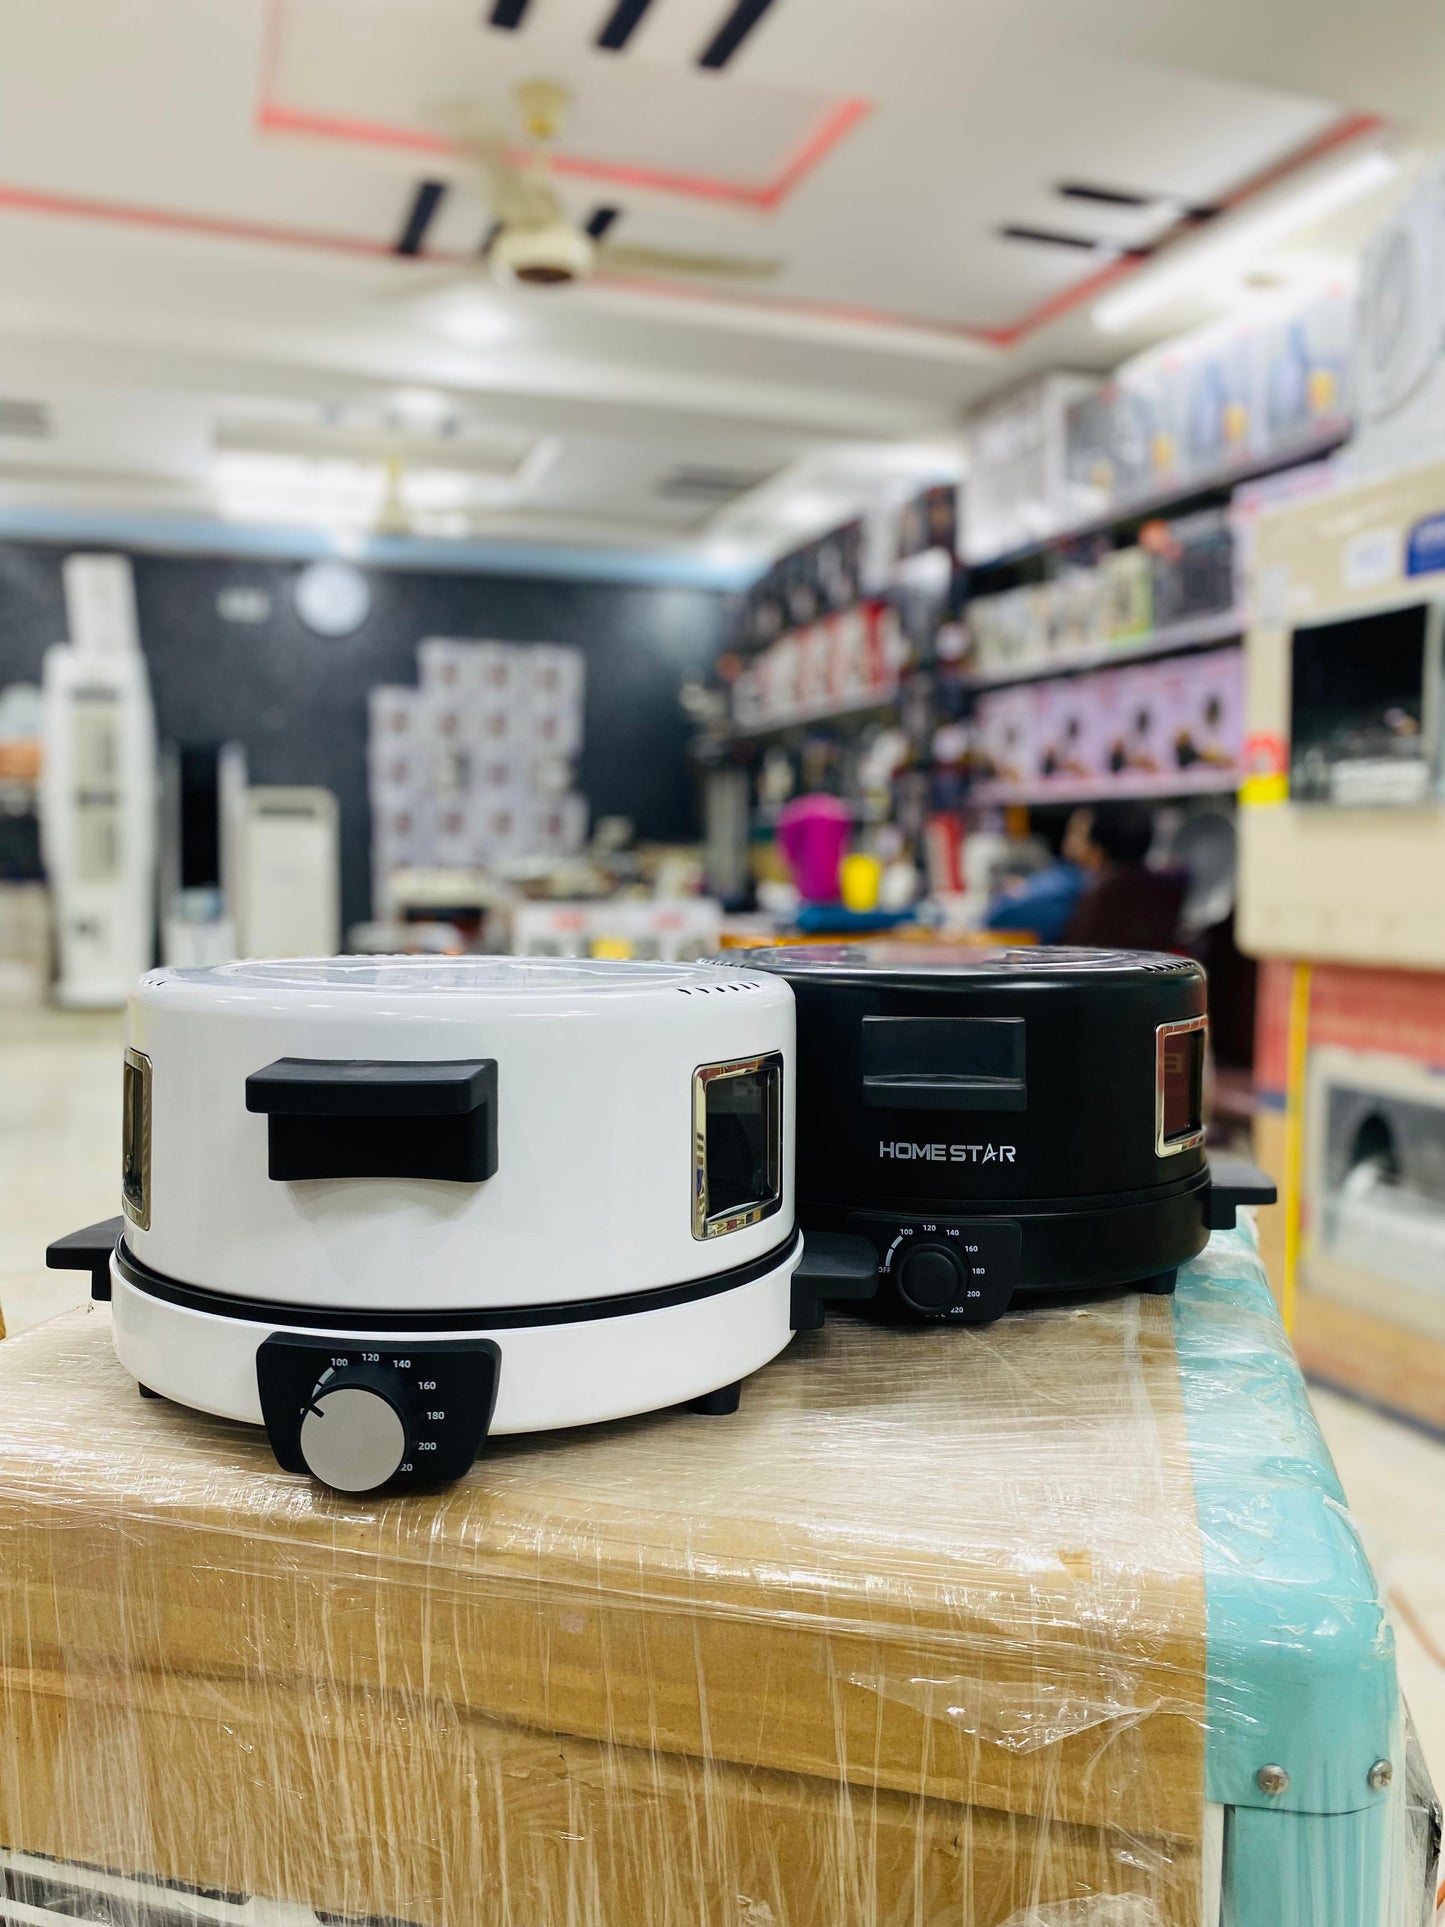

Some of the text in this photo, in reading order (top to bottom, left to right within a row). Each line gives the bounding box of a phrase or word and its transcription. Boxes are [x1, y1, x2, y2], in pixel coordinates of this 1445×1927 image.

[900, 1228, 914, 1236] 100
[922, 1224, 937, 1232] 120
[946, 1229, 960, 1237] 140
[965, 1245, 979, 1253] 160
[971, 1267, 986, 1275] 180
[966, 1290, 981, 1298] 200
[361, 1353, 380, 1362] 120
[330, 1358, 349, 1367] 100
[392, 1360, 411, 1369] 140
[418, 1381, 437, 1390] 160
[426, 1411, 445, 1420] 180
[418, 1442, 437, 1451] 200
[398, 1463, 413, 1472] 20
